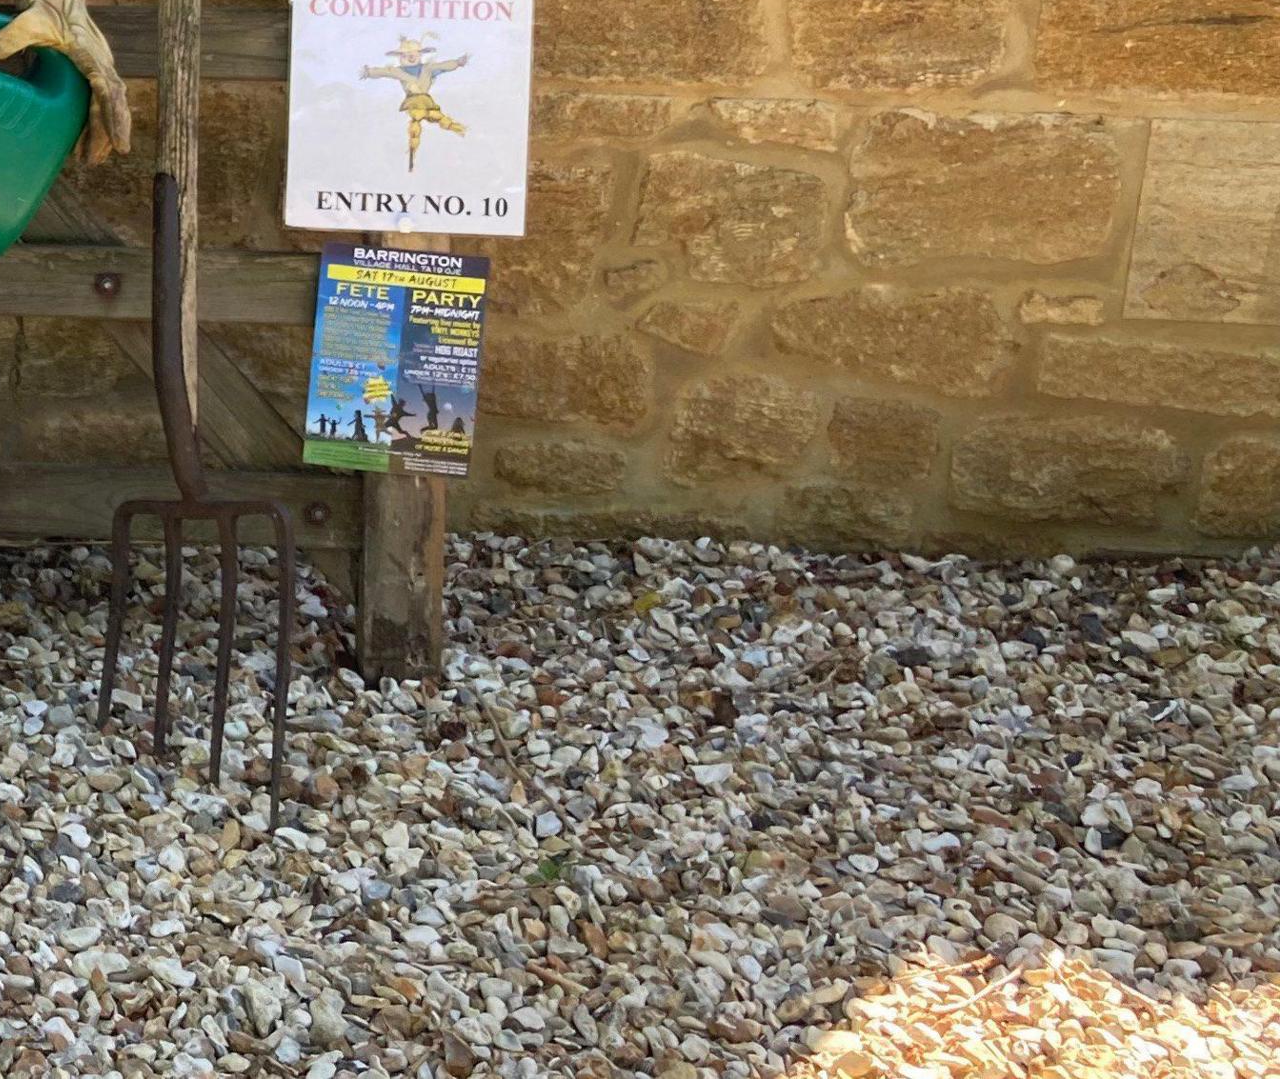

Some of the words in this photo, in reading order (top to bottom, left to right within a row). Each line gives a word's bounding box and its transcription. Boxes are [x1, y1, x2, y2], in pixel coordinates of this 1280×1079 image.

[317, 190, 418, 214] ENTRY
[423, 194, 471, 216] NO.
[483, 196, 508, 217] 10
[354, 248, 462, 268] BARRINGTON
[354, 259, 391, 269] VILLAGE
[394, 263, 418, 272] HALL
[356, 269, 378, 280] SAT
[408, 274, 457, 288] AUGUST
[336, 282, 390, 300] FETE
[412, 290, 482, 308] PARTY
[340, 298, 368, 308] NOON
[452, 346, 478, 357] ROAST
